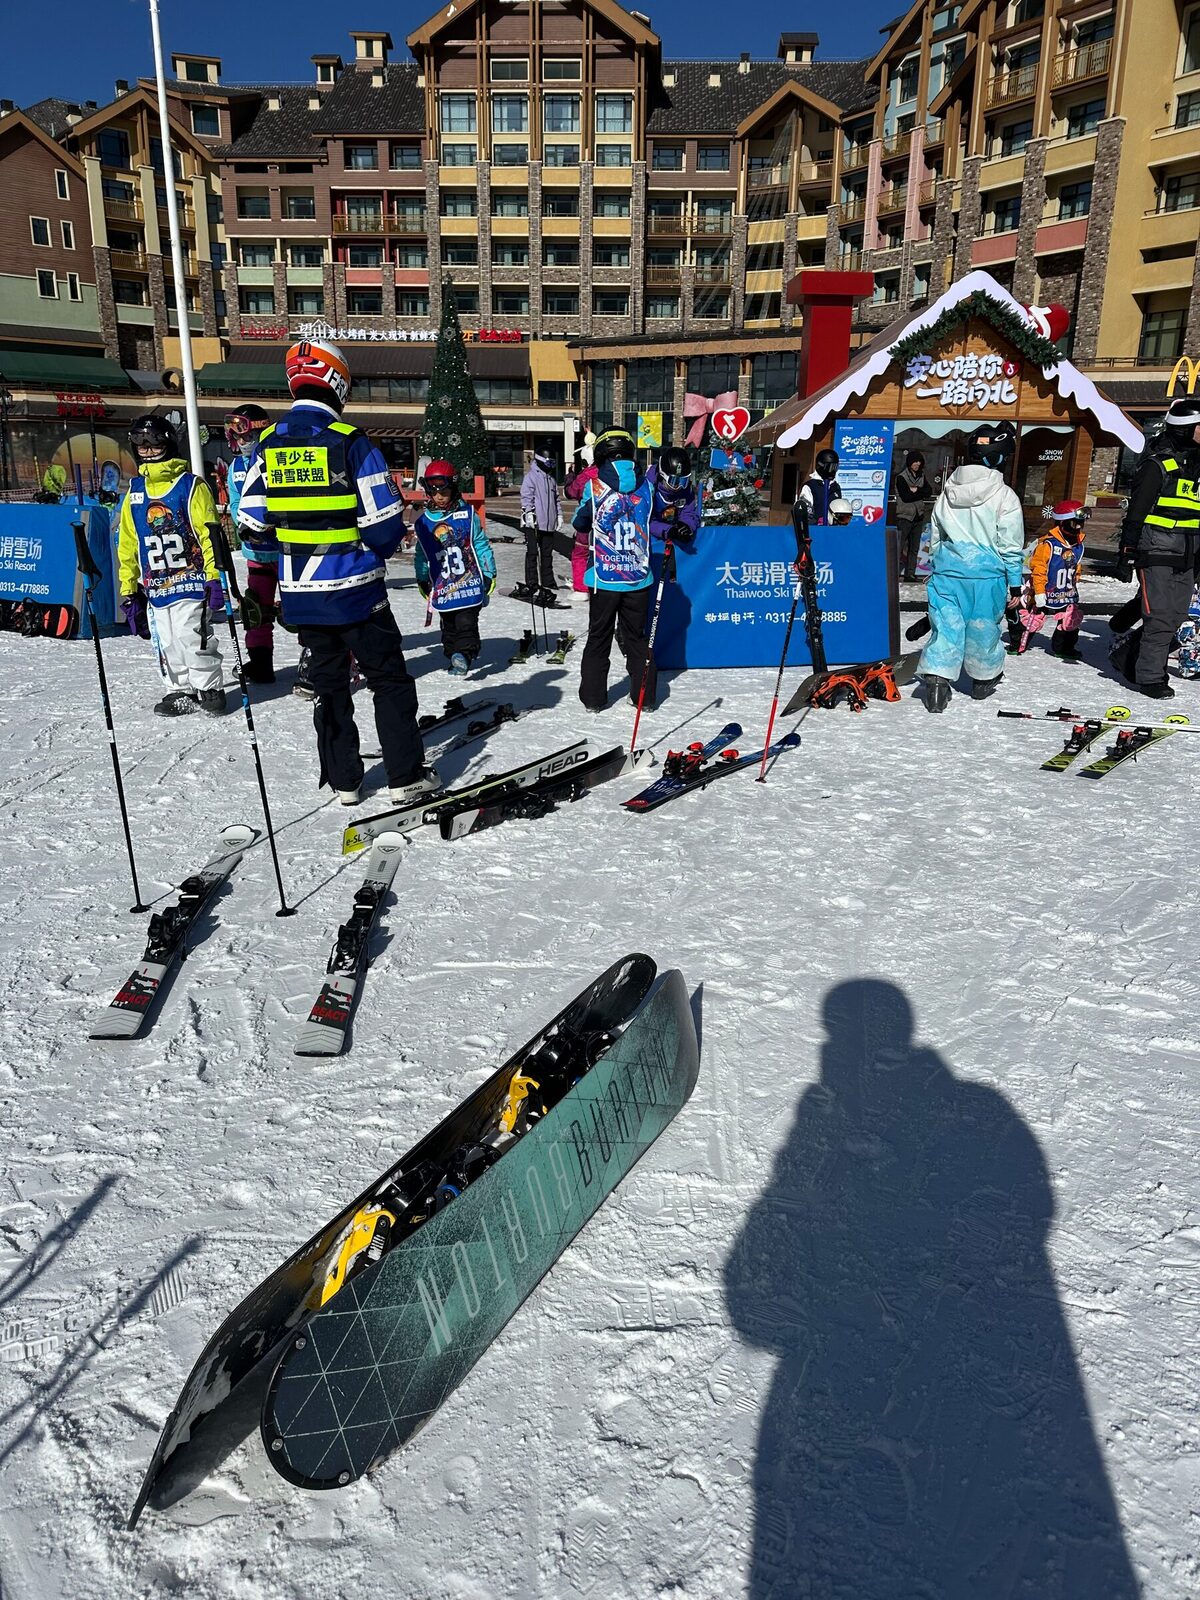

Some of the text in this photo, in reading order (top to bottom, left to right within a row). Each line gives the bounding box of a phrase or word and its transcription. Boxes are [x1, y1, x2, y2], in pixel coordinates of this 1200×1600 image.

[904, 352, 1004, 389] 安心陪你
[917, 379, 1018, 410] 一路向北
[275, 450, 316, 466] 青少年
[271, 468, 325, 484] 滑雪联盟
[614, 521, 636, 551] 12
[0, 536, 42, 560] 滑雪场
[144, 533, 187, 571] 22
[4, 560, 36, 571] Ski Resort
[435, 546, 466, 579] 33
[147, 572, 206, 587] TOGETHER SKI
[724, 587, 826, 599] Thaiwoo Ski Rrt
[538, 751, 588, 778] HEAD
[403, 785, 423, 794] HEAD
[346, 835, 362, 846] e-SL
[115, 991, 151, 1006] REACT
[311, 1014, 322, 1022] RT
[312, 1005, 348, 1022] REACT
[570, 1035, 675, 1188] BURTON
[416, 1141, 576, 1356] BURTON
